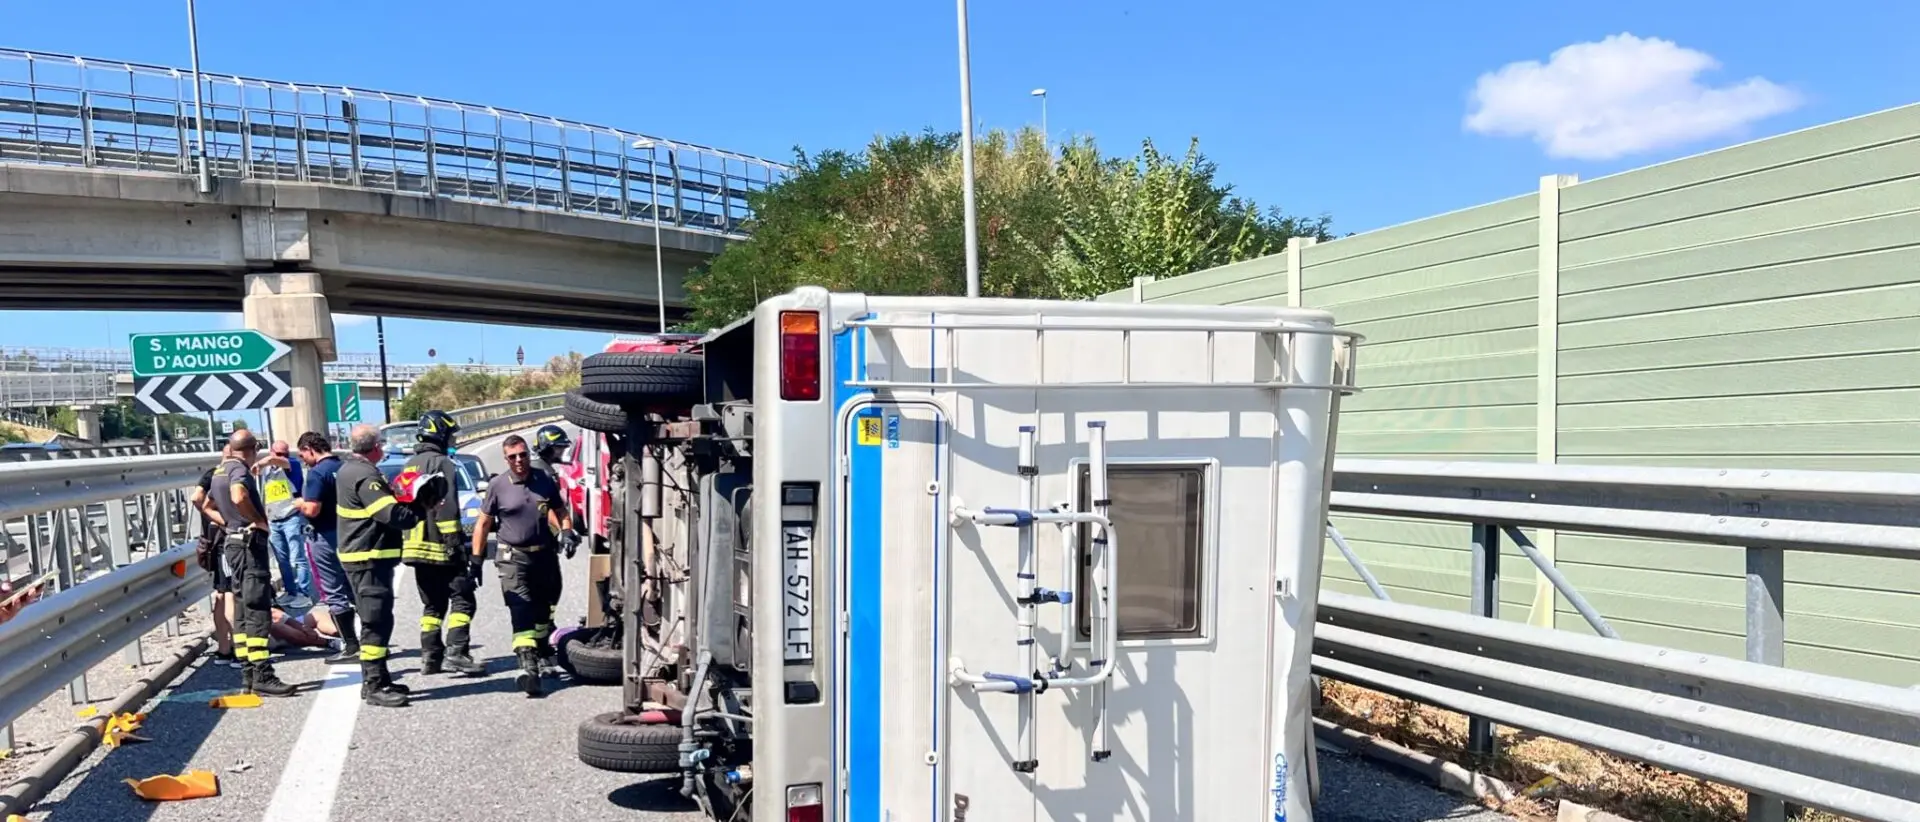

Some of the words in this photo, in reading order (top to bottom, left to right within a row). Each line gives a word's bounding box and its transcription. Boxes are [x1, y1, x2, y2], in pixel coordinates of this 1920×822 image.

[149, 338, 168, 352] S.
[175, 335, 243, 351] MANGO
[153, 352, 242, 369] D'AQUINO
[787, 574, 809, 617] 572
[787, 627, 809, 654] LF
